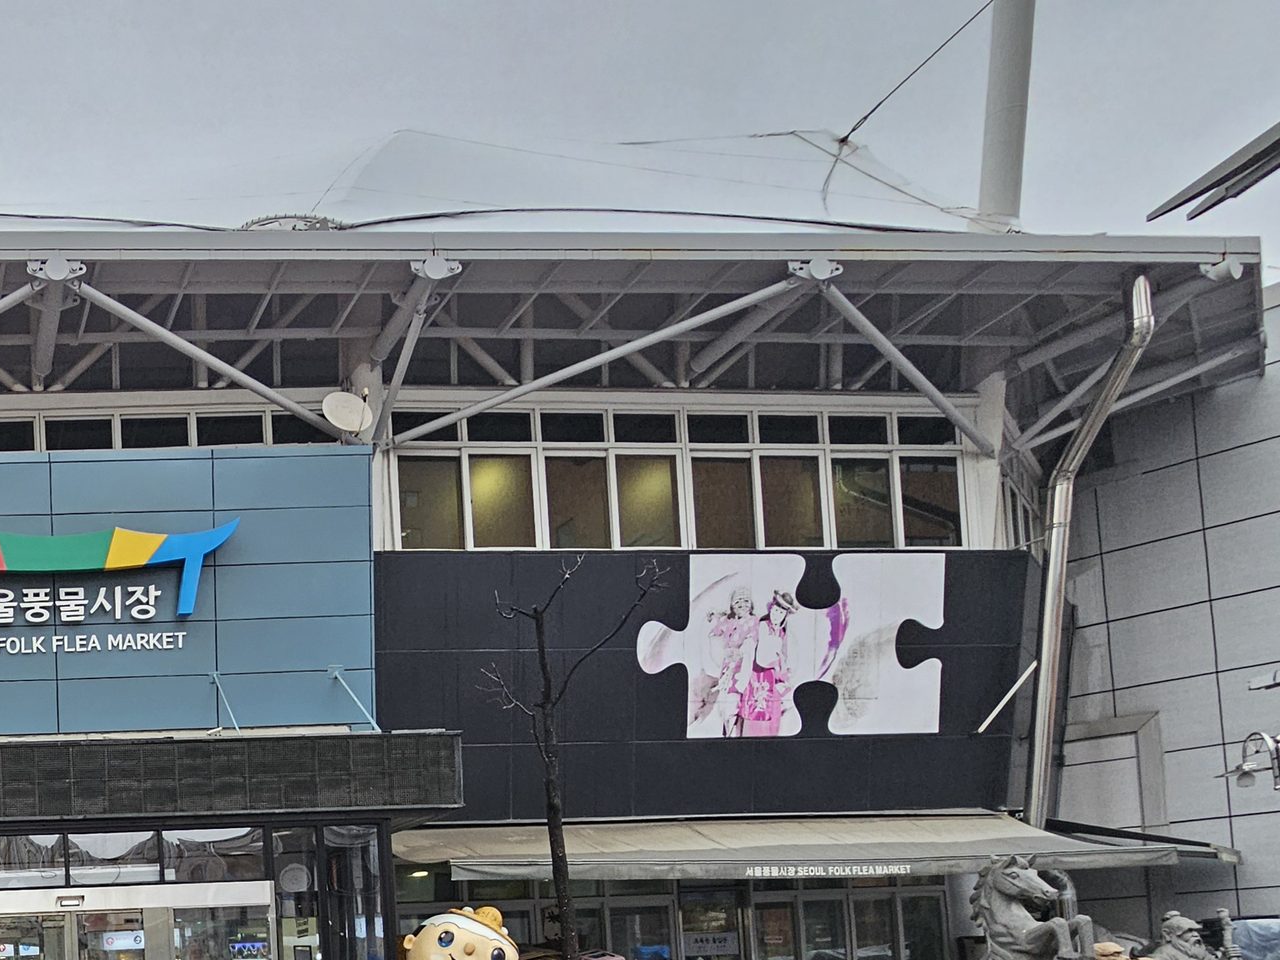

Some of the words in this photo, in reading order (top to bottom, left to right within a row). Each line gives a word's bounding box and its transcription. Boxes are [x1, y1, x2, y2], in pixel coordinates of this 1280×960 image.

[51, 633, 102, 653] FLEA
[107, 631, 187, 651] MARKET
[745, 866, 796, 876] 서울풍물시장
[797, 866, 826, 876] SEOUL
[828, 865, 851, 876] FOLK
[852, 865, 875, 875] FLEA
[875, 864, 912, 875] MARKET
